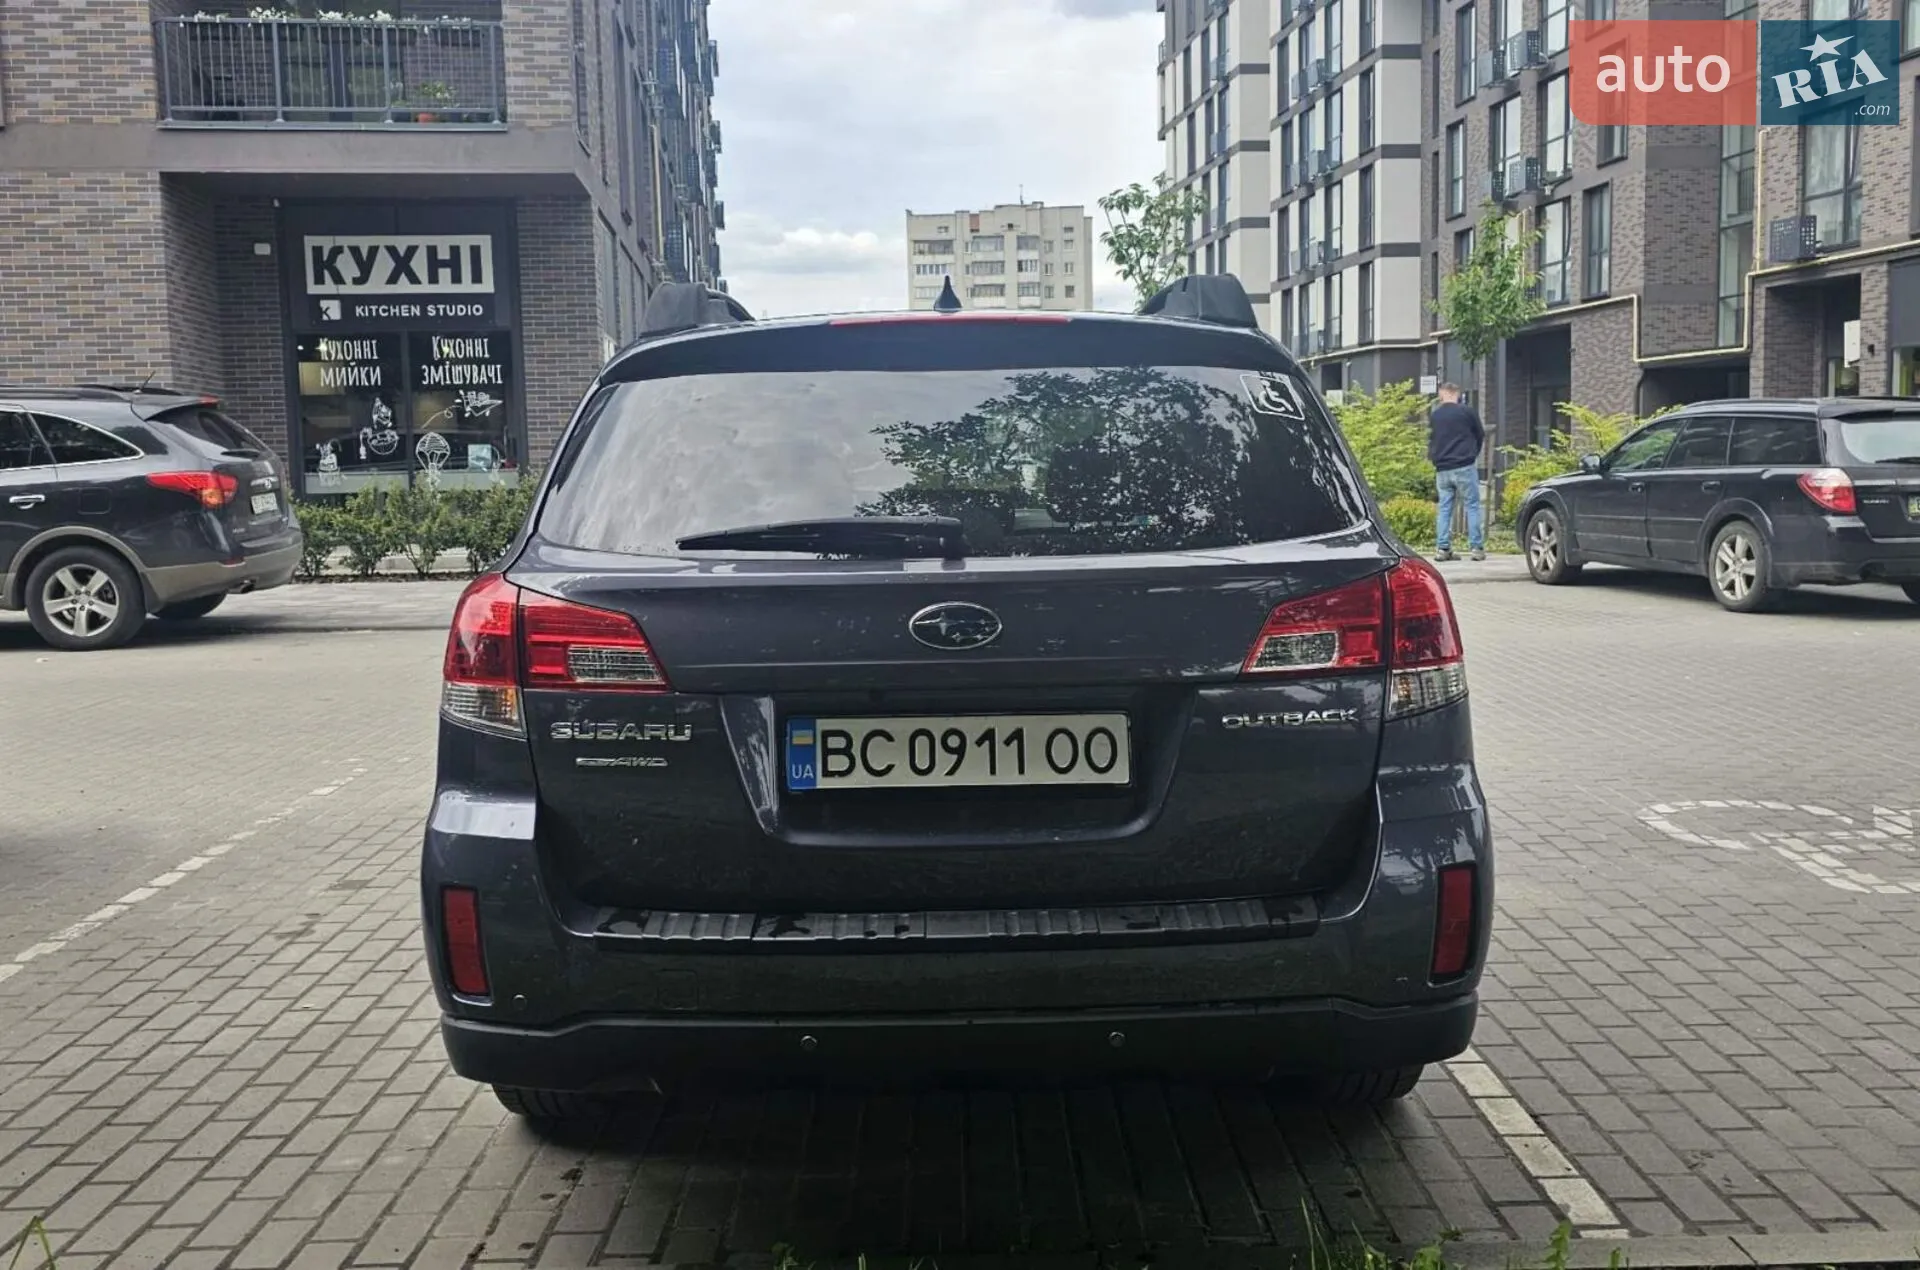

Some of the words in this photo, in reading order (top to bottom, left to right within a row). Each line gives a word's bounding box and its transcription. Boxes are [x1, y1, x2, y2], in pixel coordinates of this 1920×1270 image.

[311, 244, 484, 286] КУХНІ
[355, 304, 421, 317] KITCHEN
[427, 304, 484, 316] STUDIO
[1221, 708, 1358, 729] OUTBACK
[550, 721, 692, 741] SUBARU
[820, 729, 896, 778] BC
[908, 727, 1026, 776] 0911
[791, 764, 815, 779] UA
